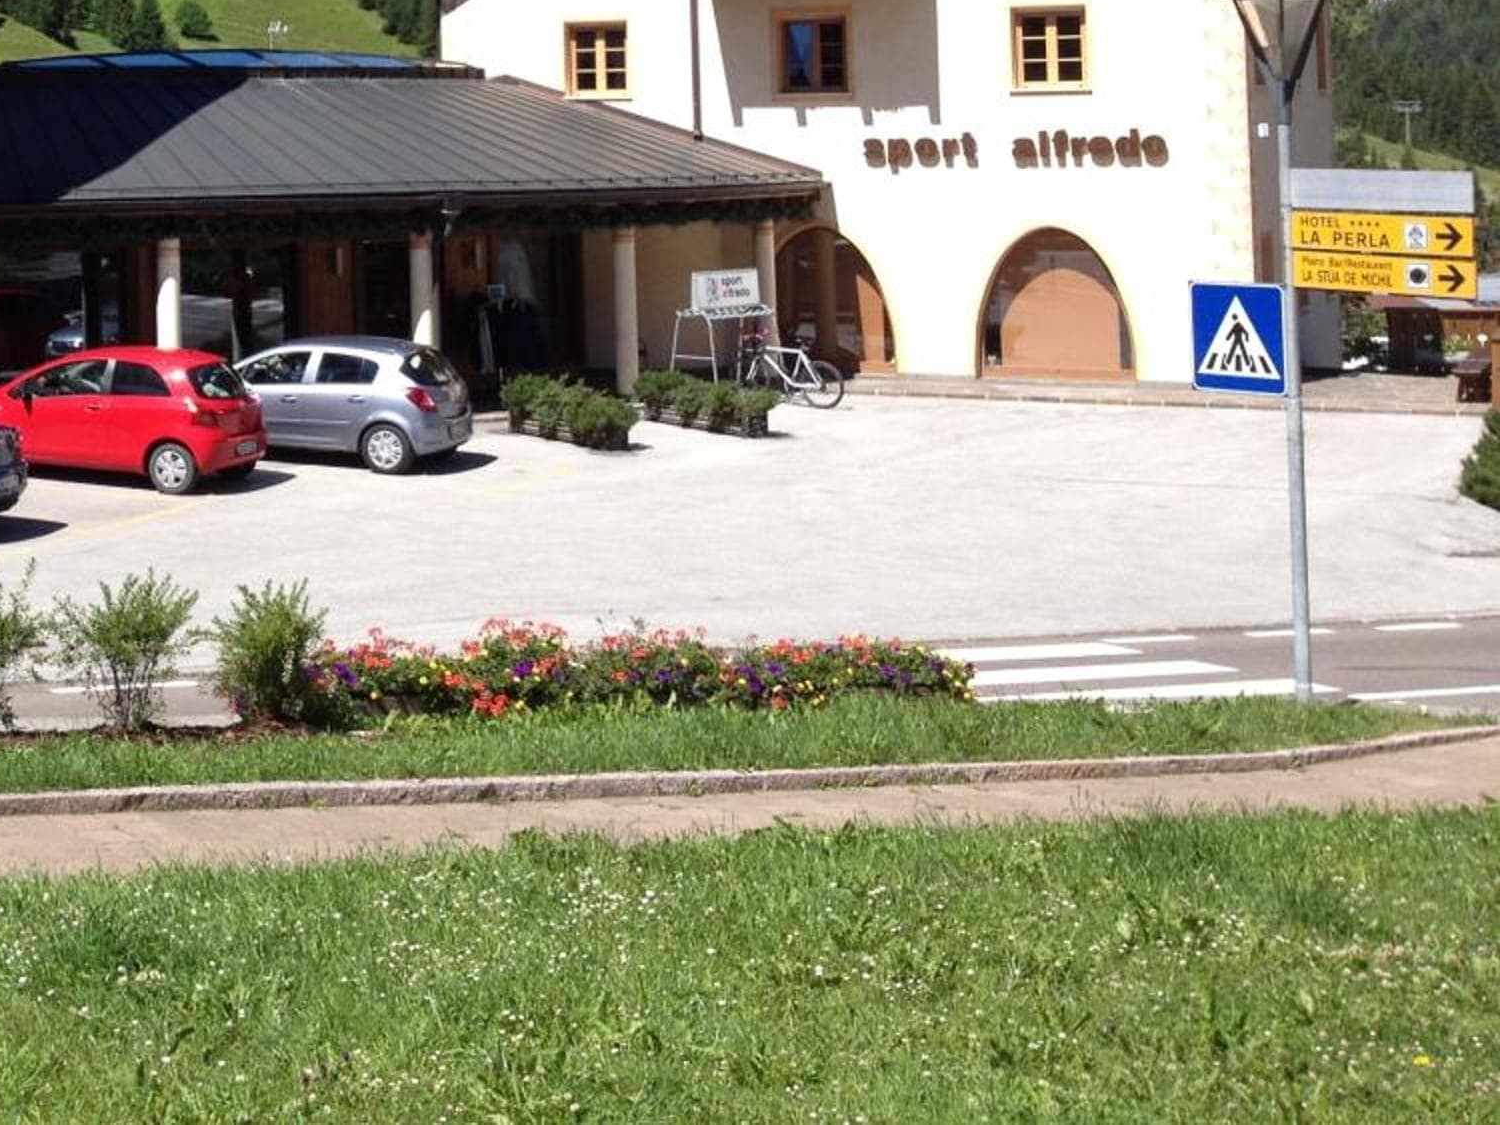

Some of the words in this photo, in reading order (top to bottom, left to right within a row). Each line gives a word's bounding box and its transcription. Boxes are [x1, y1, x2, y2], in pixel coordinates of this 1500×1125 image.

[864, 132, 978, 174] sport
[1012, 129, 1168, 168] alfredo
[1300, 216, 1340, 228] HOTEL
[1301, 230, 1320, 245] LA
[1333, 231, 1390, 248] PERLA
[1344, 272, 1357, 286] DE
